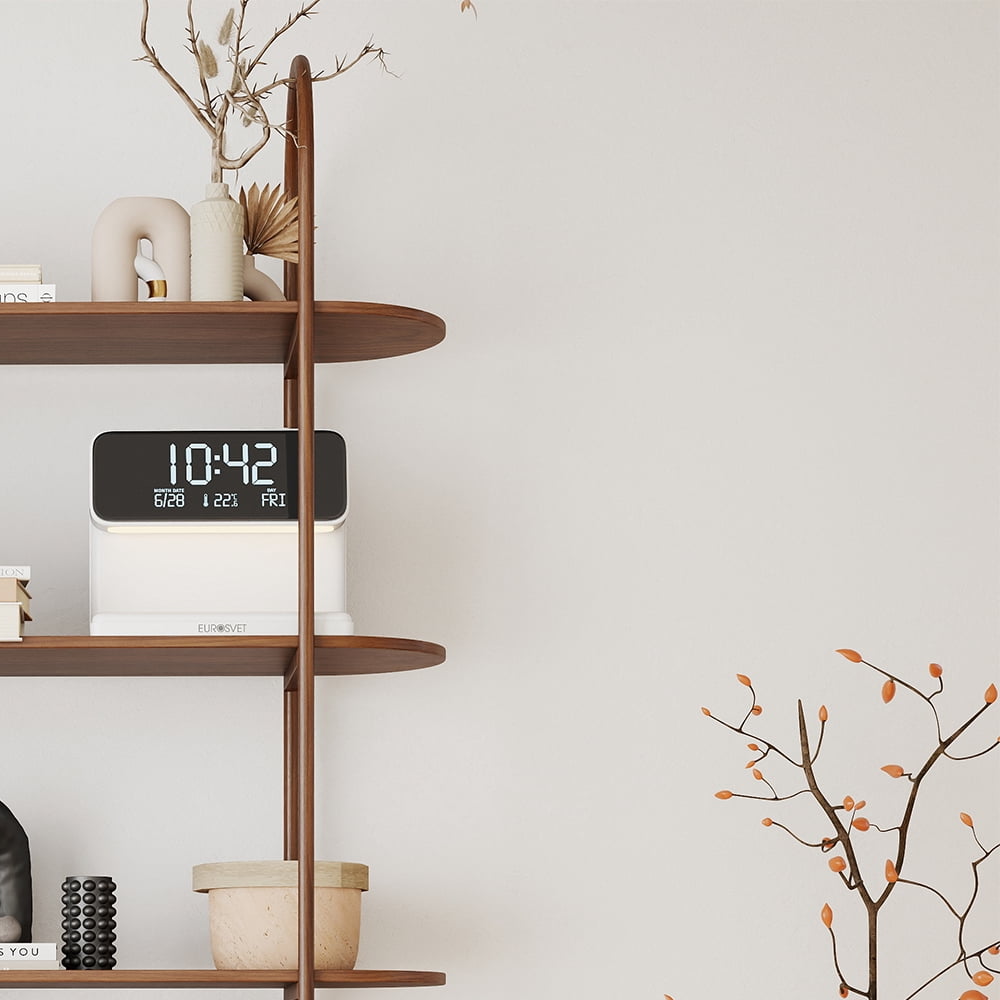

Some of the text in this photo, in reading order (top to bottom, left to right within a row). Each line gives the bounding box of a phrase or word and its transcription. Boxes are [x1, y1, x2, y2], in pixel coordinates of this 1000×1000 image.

[169, 442, 278, 486] 10:42
[154, 493, 185, 508] 6/28
[261, 493, 286, 507] FRI
[197, 623, 247, 633] EUROSVET
[10, 948, 39, 957] YOU
